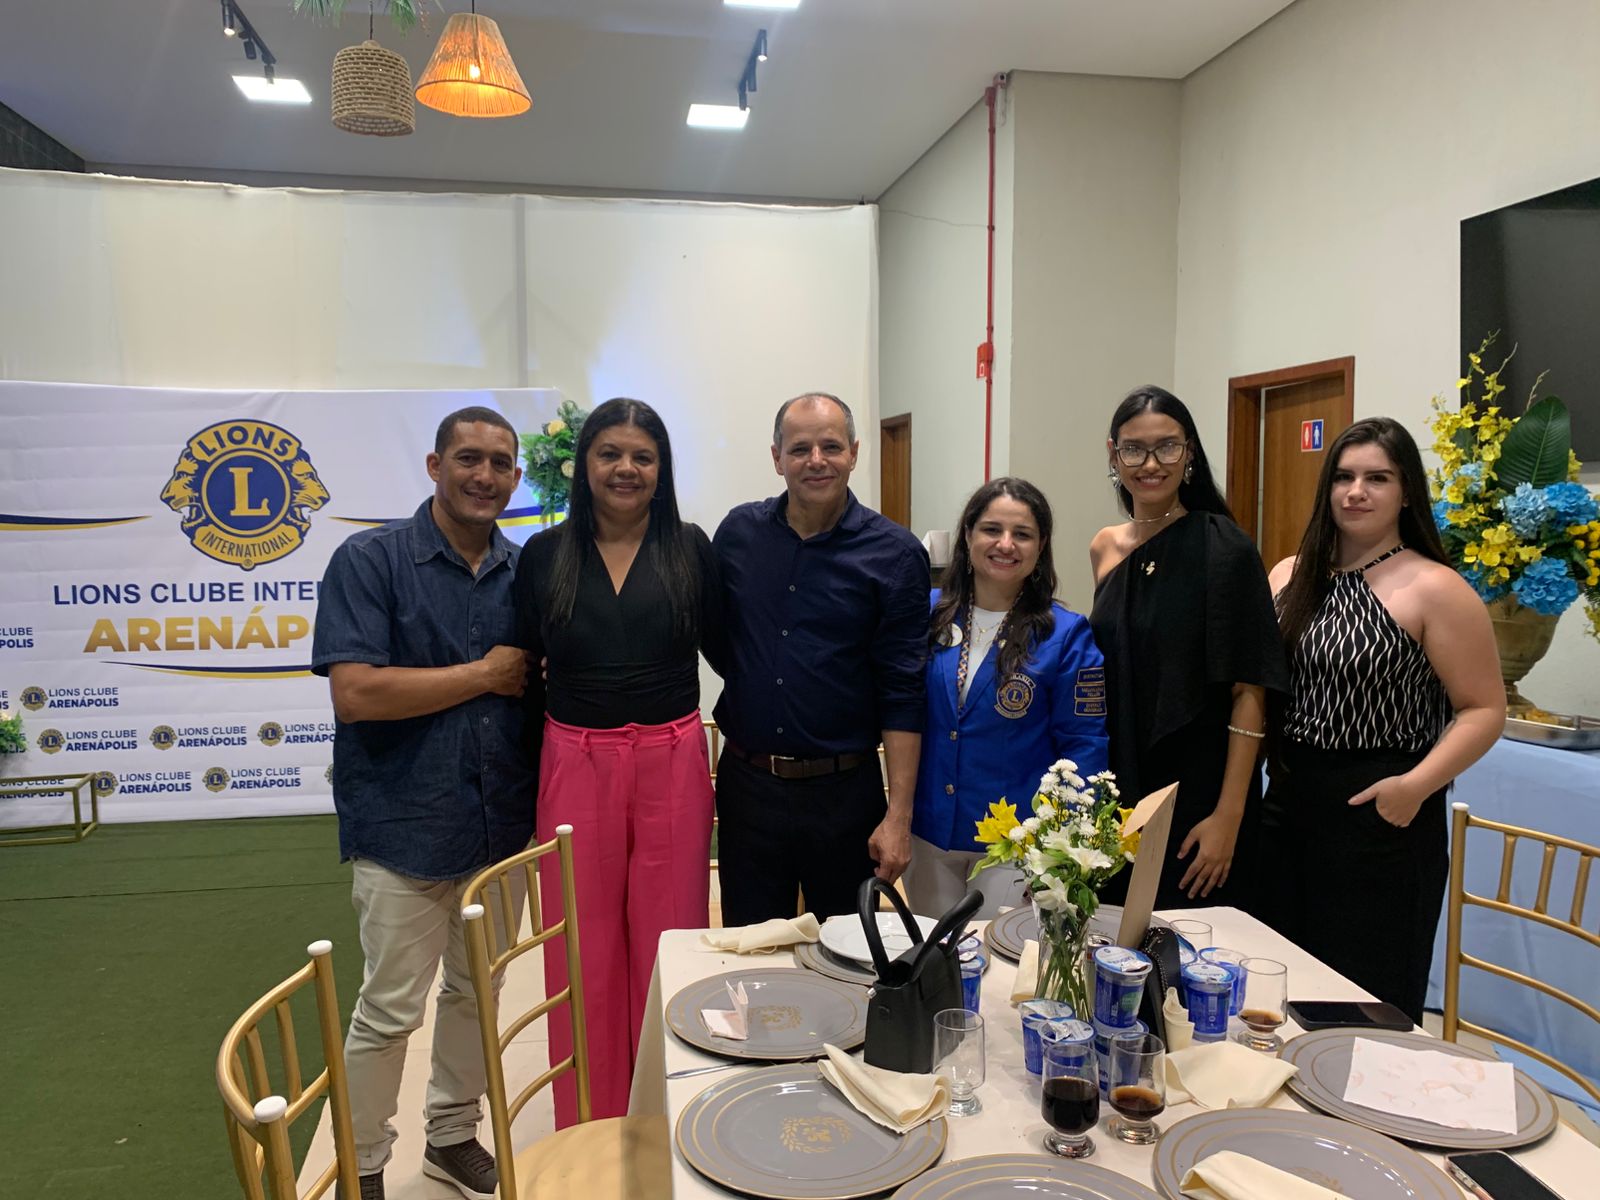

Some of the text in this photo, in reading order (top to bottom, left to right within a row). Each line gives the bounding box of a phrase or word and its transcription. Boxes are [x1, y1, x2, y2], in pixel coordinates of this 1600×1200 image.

[197, 425, 293, 457] LIONS
[229, 467, 271, 516] L
[201, 531, 294, 558] INTERNATIONAL
[54, 581, 322, 605] LIONS CLUBE INTE
[0, 627, 33, 636] LUBE
[83, 605, 315, 653] ARENÁP
[48, 687, 119, 697] LIONS CLUBE
[48, 697, 119, 708] ARENÁPOLIS
[178, 726, 247, 736] LIONS CLUBE
[284, 724, 315, 732] LIONS
[66, 730, 137, 739] LIONS CLUBE
[66, 739, 138, 751] ARENÁPOLIS
[178, 736, 247, 747] ARENÁPOLIS
[119, 771, 191, 782] LIONS CLUBE
[231, 767, 301, 777] LIONS CLUBE
[119, 781, 192, 794] ARENÁPOLIS
[230, 777, 301, 789] ARENÁPOLIS
